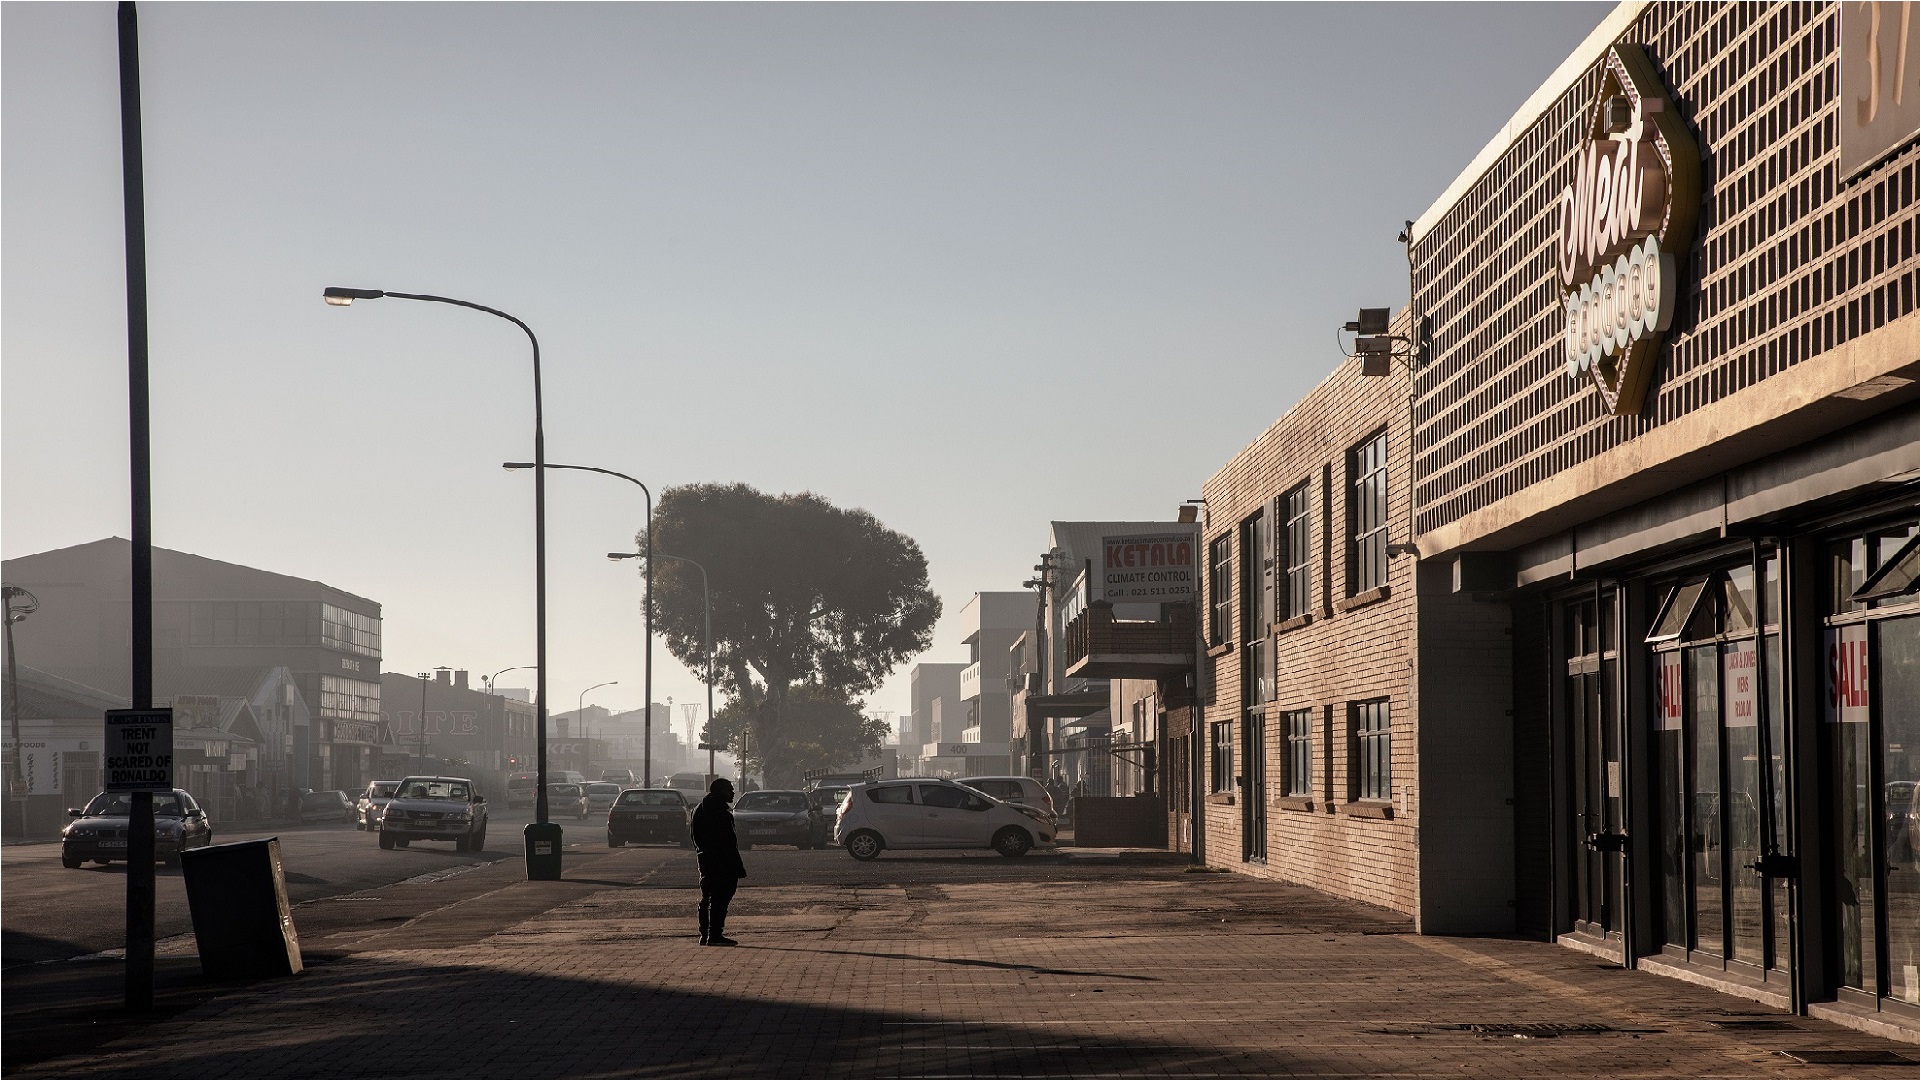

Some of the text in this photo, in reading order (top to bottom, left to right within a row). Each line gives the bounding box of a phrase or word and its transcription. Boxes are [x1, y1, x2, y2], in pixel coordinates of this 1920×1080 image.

[1559, 98, 1644, 286] Meat
[1107, 542, 1191, 568] KETALA
[1107, 571, 1191, 583] CLIMATE CONTROL
[1107, 589, 1124, 597] Call
[1131, 588, 1147, 596] 021
[1150, 587, 1166, 595] 511
[1168, 586, 1191, 594] 0251
[1829, 641, 1868, 709] SALE
[121, 727, 157, 740] TRENT
[127, 742, 150, 754] NOT
[548, 742, 583, 755] KFC
[950, 744, 967, 755] 400
[107, 755, 171, 769] SCARED OF
[111, 769, 167, 782] RONALDO
